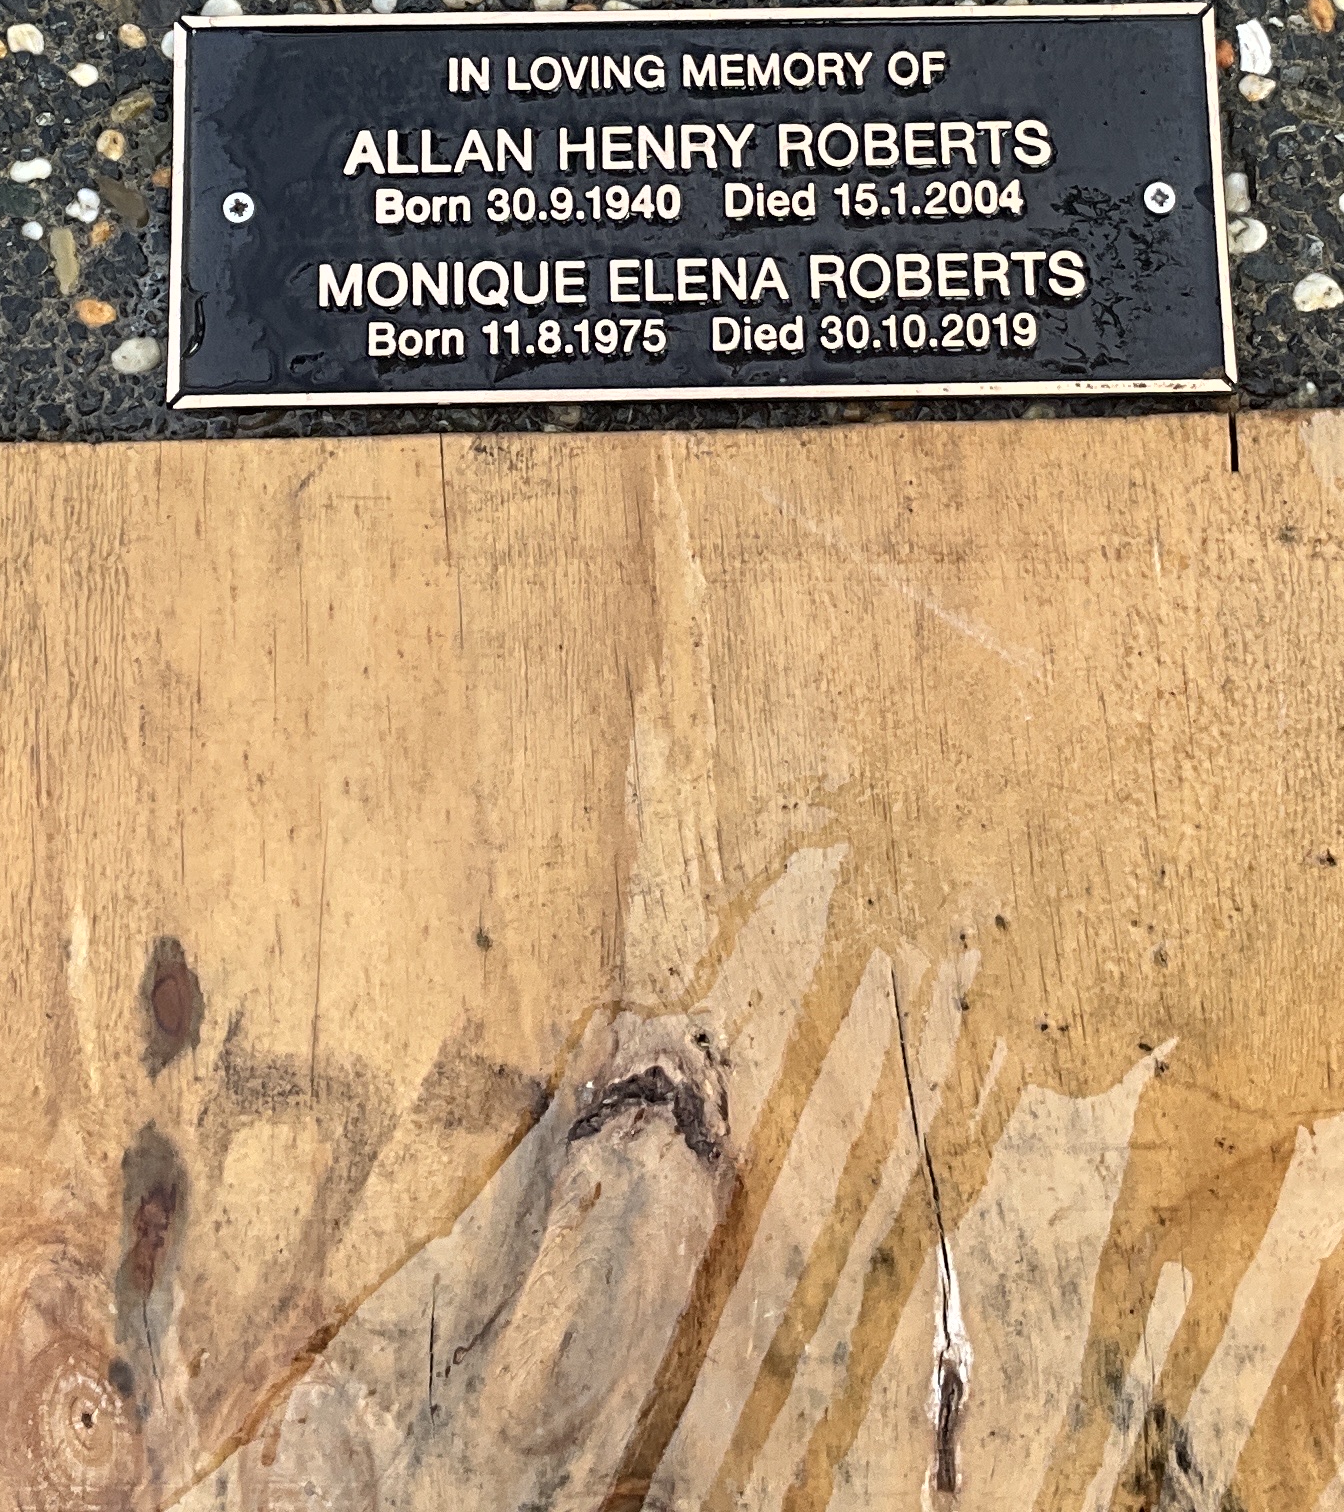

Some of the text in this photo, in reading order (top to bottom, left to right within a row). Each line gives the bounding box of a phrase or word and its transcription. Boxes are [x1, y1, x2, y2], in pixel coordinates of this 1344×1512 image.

[447, 49, 947, 94] IN LOVING MEMORY OF
[342, 118, 1053, 177] ALLAN HENRY ROBERTS
[374, 178, 1025, 225] Born 30.9.1940 Died 15.1.2004
[318, 249, 1087, 308] MONIQUE ELENA ROBERTS
[367, 311, 1038, 358] Born 11.8.1975 Died 30.10.2019
